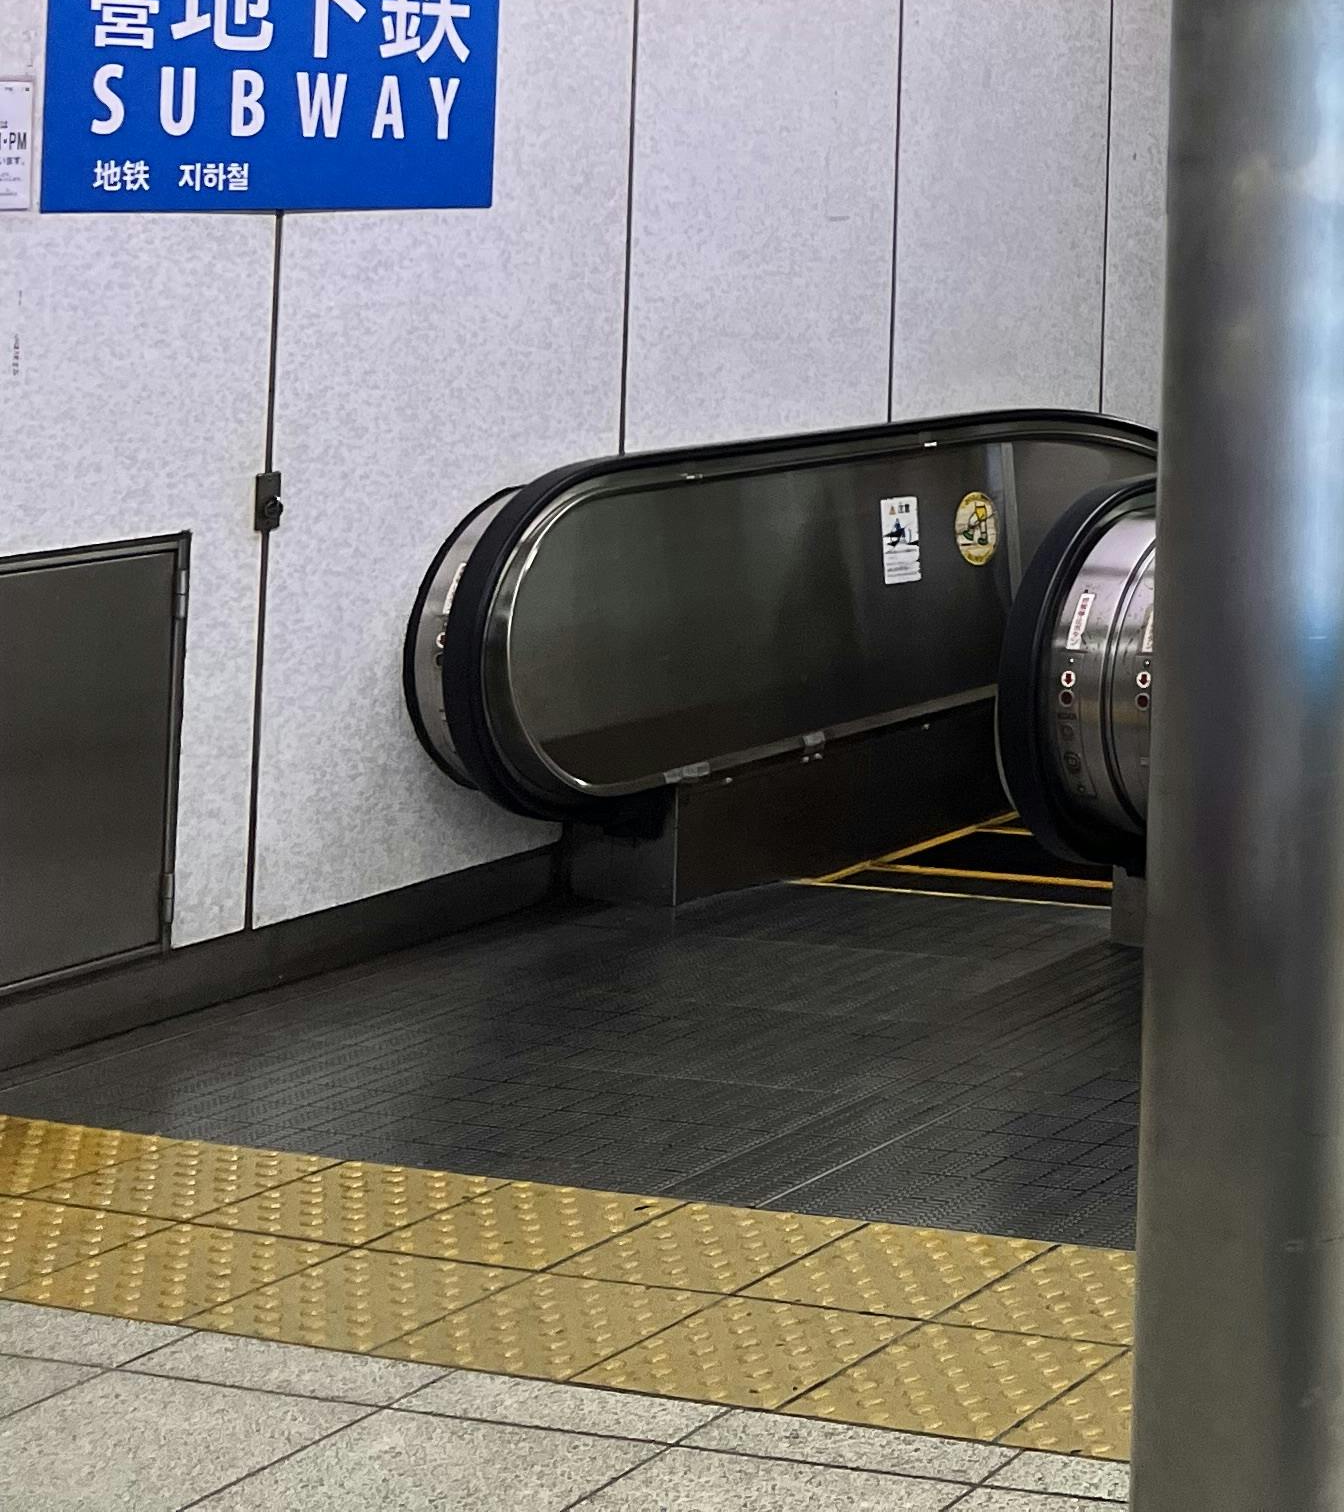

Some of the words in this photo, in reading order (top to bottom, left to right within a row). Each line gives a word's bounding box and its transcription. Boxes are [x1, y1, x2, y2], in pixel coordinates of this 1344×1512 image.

[90, 64, 460, 139] SUBWAY
[93, 160, 150, 191] 地铁
[178, 163, 250, 192] 지하철
